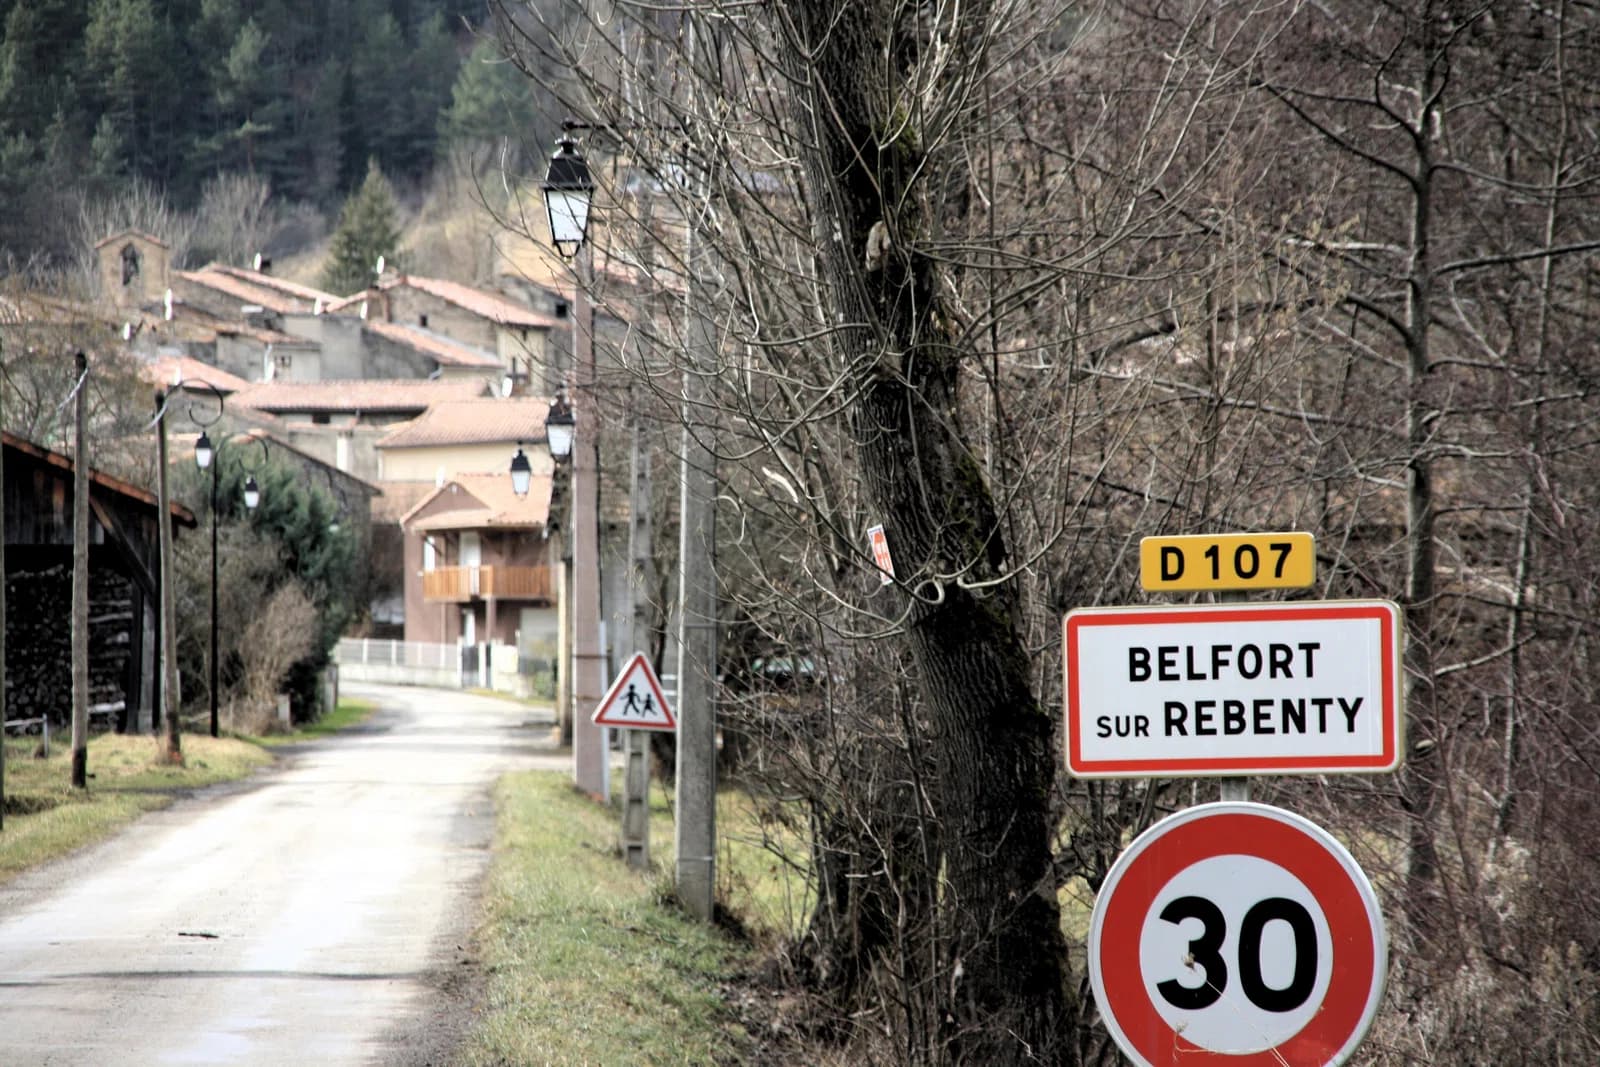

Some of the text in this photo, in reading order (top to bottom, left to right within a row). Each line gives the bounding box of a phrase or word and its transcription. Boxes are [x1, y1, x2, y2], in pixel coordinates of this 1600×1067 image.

[1160, 543, 1292, 581] D 107
[1128, 643, 1321, 682] BELFORT
[1096, 697, 1364, 738] SUR REBENTY
[1156, 895, 1318, 1013] 30
